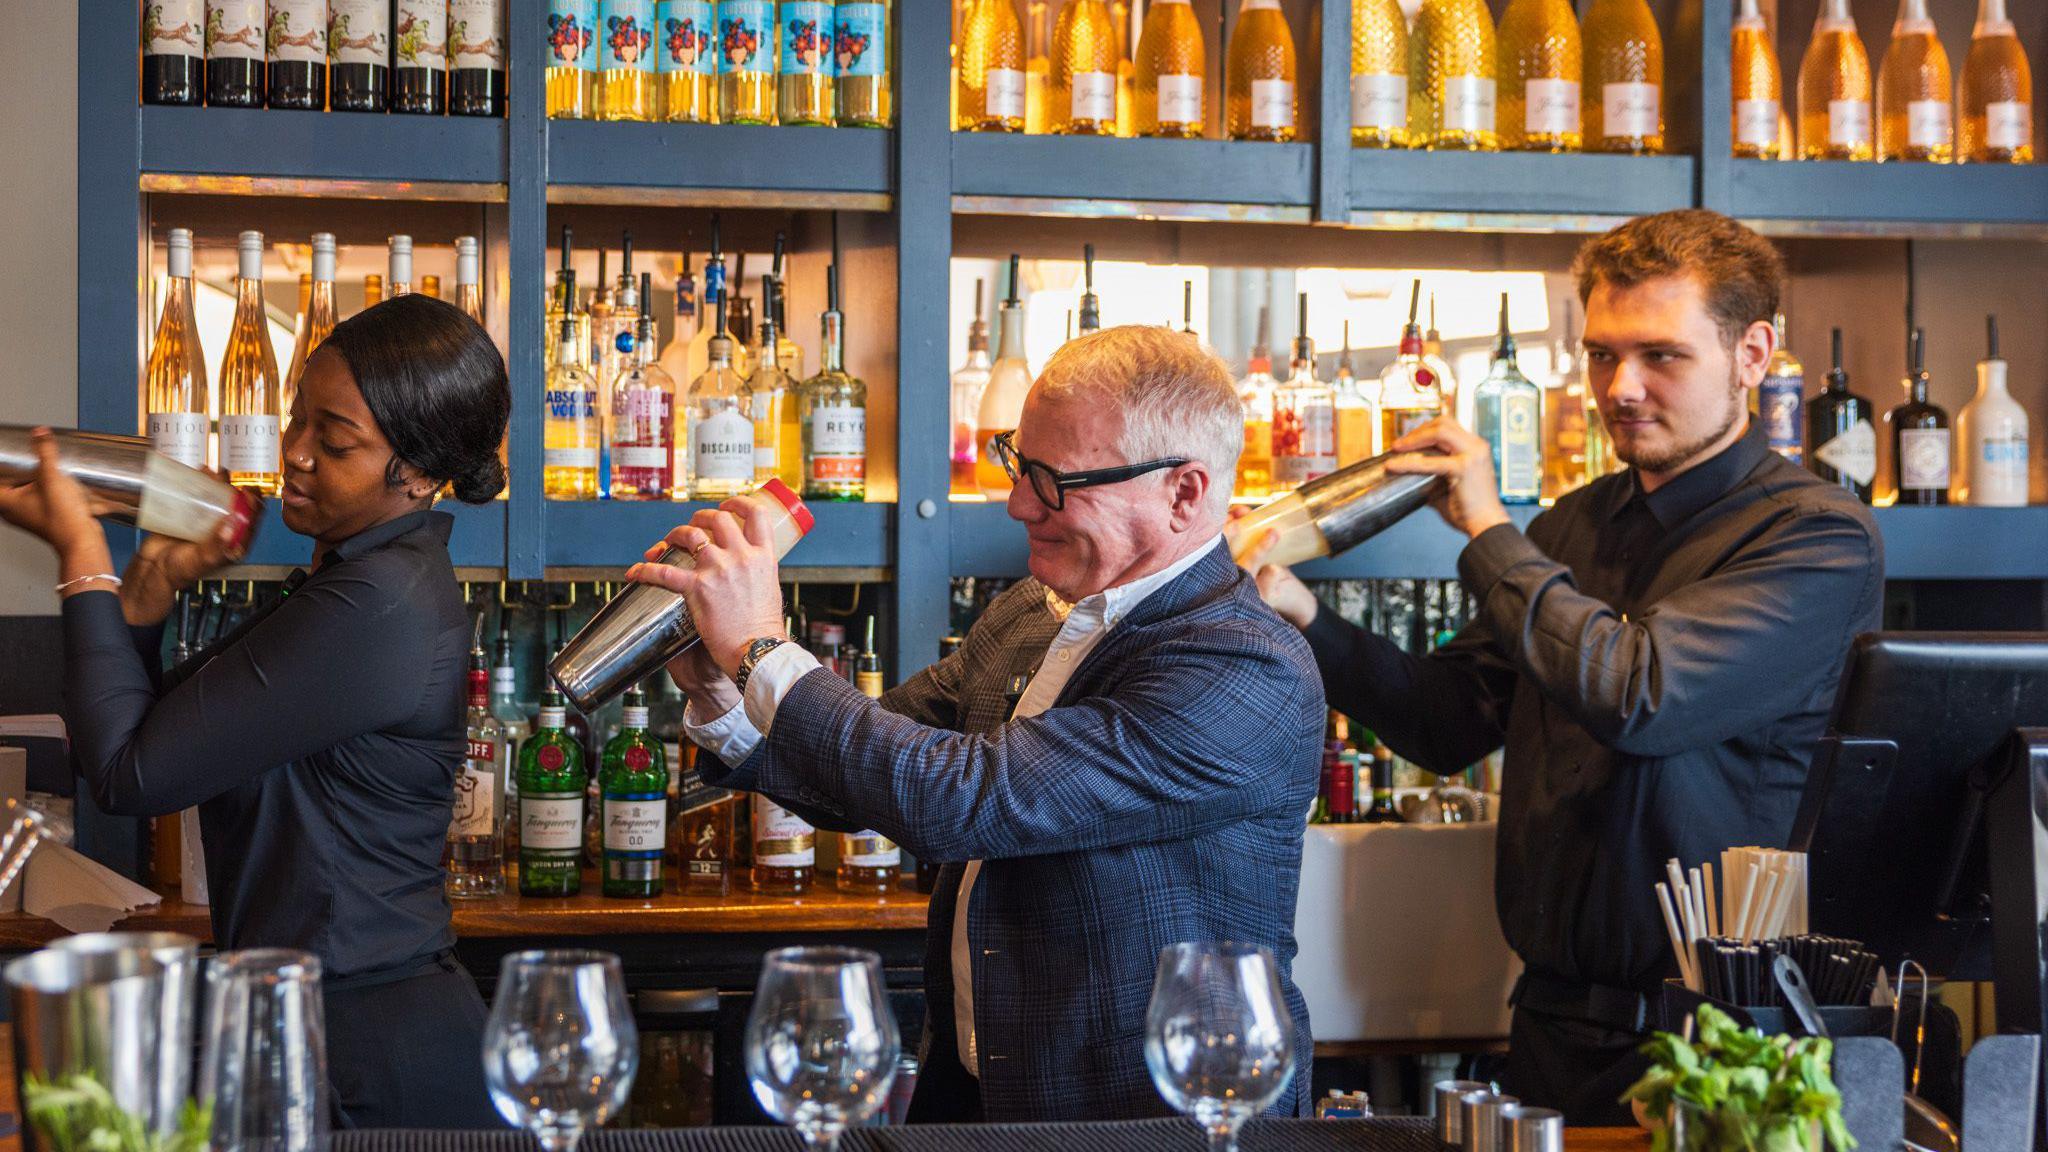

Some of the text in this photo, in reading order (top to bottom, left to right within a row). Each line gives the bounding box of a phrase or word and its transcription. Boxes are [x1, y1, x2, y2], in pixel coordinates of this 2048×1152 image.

[545, 390, 597, 403] ABSOUT
[551, 403, 594, 417] VODA
[700, 862, 712, 873] 12
